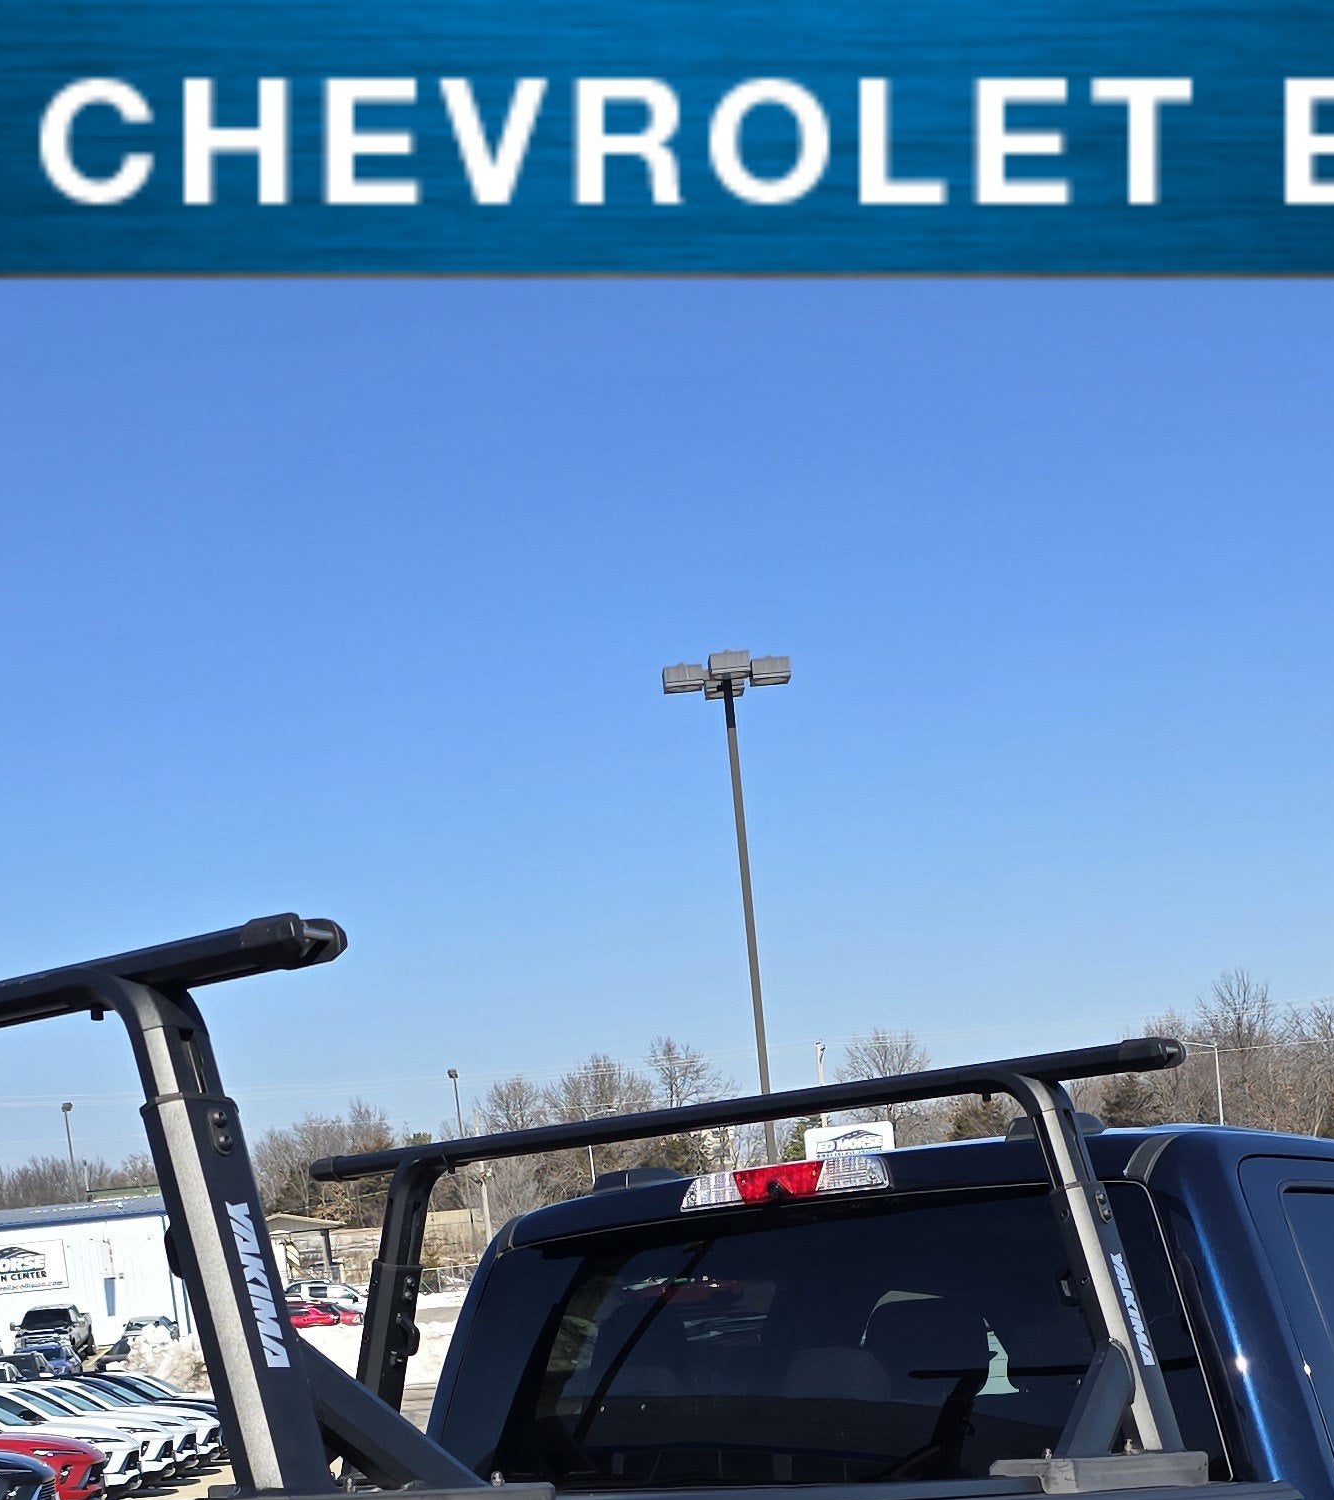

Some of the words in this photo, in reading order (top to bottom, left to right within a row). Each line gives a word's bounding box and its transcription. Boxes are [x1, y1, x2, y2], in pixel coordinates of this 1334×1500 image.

[10, 1271, 48, 1282] CENTER
[224, 1201, 291, 1368] YAKIMA
[1109, 1252, 1156, 1366] YAKIMA
